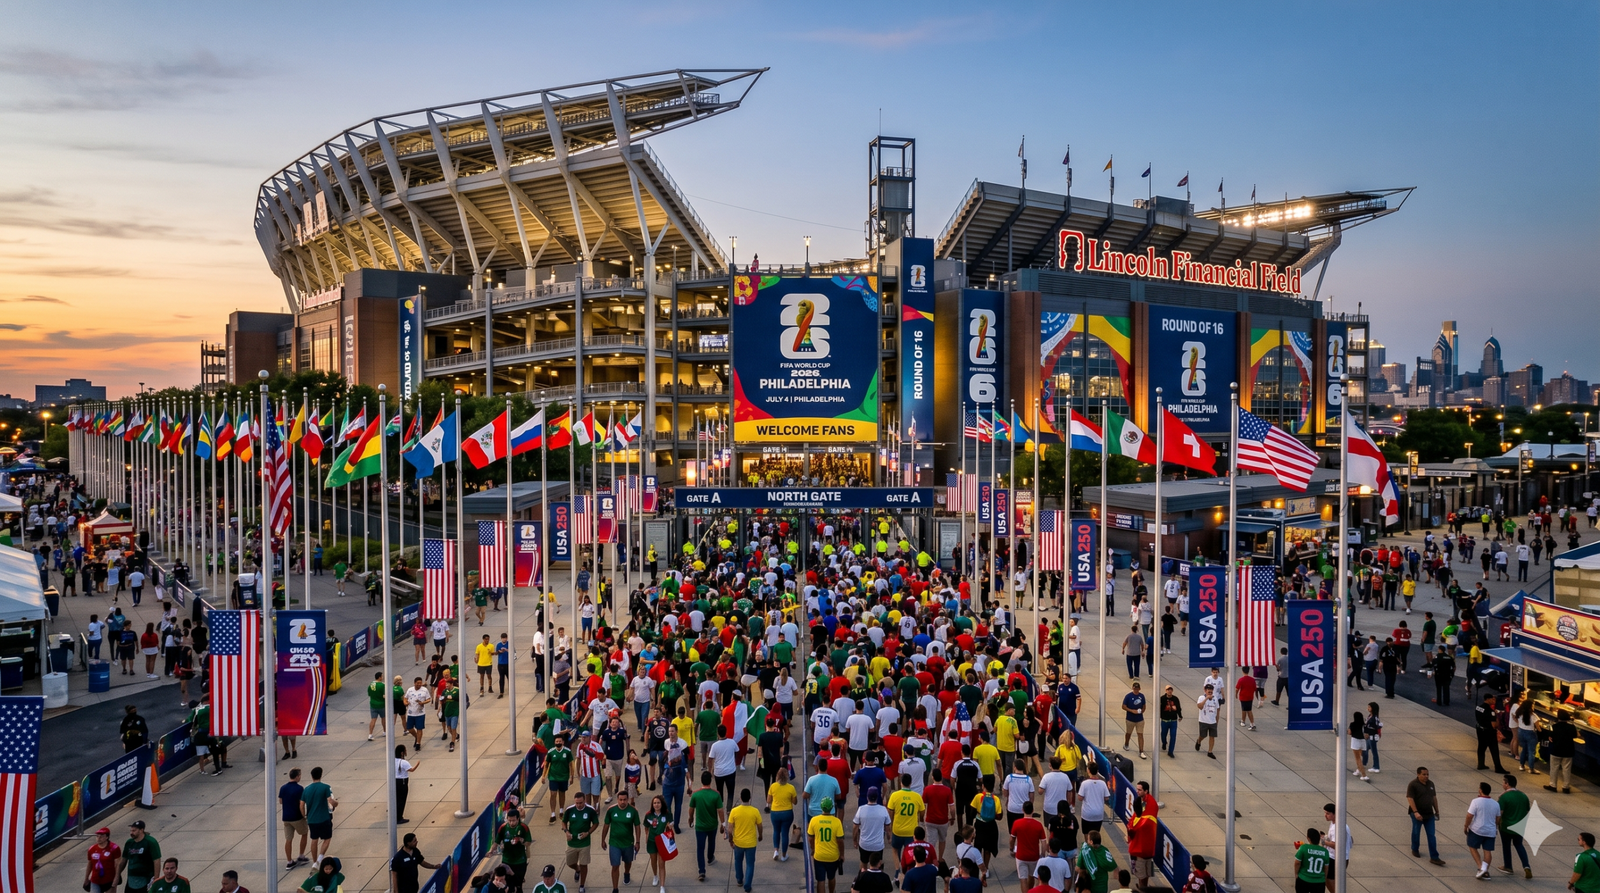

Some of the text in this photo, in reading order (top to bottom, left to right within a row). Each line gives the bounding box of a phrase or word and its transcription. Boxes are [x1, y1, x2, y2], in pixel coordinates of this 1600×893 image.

[1087, 238, 1302, 294] Lincoln Financial Field
[1161, 318, 1224, 335] ROUND OF 16
[790, 369, 820, 377] 2026
[914, 330, 923, 400] ROUND OF 16
[759, 378, 851, 389] PHILADELPHIA
[1167, 404, 1218, 413] PHILADELPHIA
[756, 425, 855, 436] WELCOME FANS
[686, 492, 722, 504] GATE A
[767, 491, 842, 501] NORTH GATE
[886, 491, 921, 503] GATE A
[982, 485, 990, 519] USA250
[996, 492, 1006, 534] USA250
[556, 506, 567, 555] USA250
[1077, 524, 1091, 582] USA250
[1199, 574, 1218, 658] USA250
[1300, 609, 1324, 714] USA250
[817, 715, 830, 728] 36
[900, 802, 915, 817] 20
[819, 827, 832, 842] 10
[1307, 856, 1324, 874] 10
